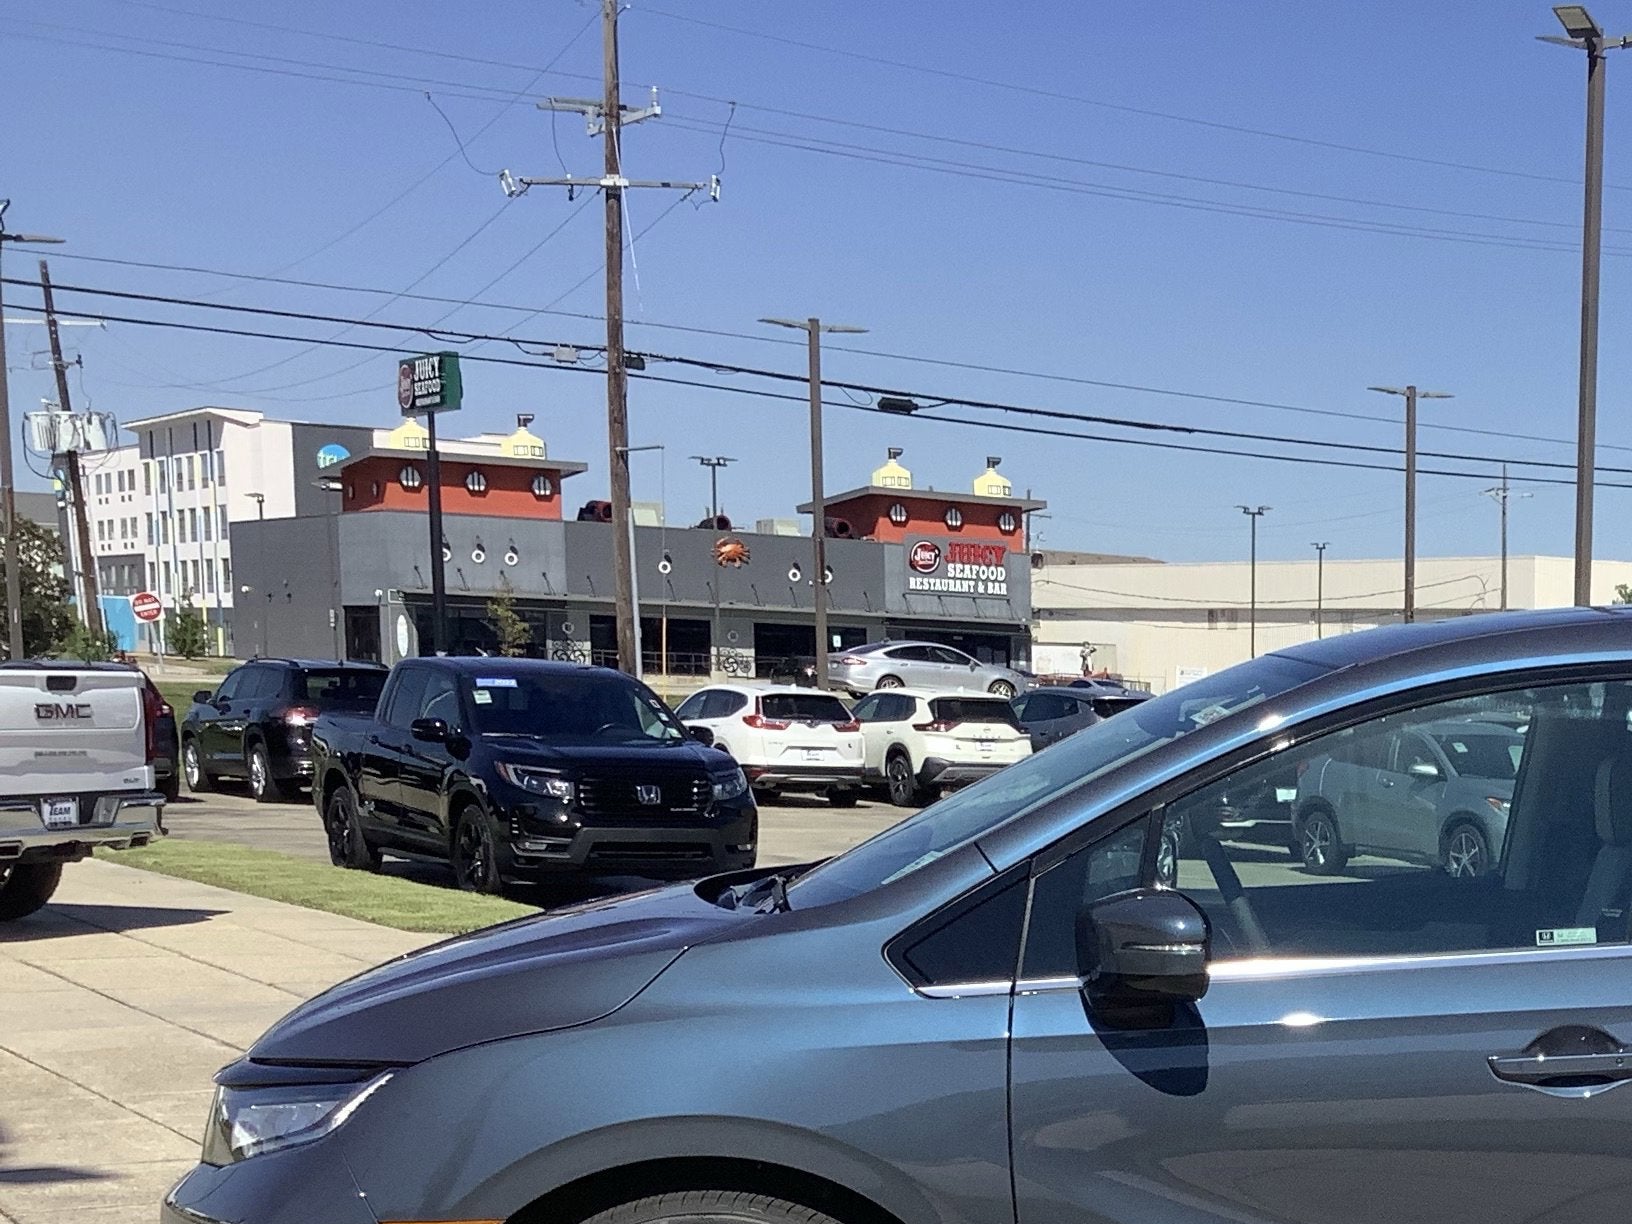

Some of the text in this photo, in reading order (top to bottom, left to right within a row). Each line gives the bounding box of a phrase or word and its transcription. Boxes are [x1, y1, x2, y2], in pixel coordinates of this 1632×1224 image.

[413, 356, 440, 381] JUICY
[944, 541, 1007, 567] JUICY
[947, 563, 1006, 581] SEAFOOD
[909, 577, 1007, 595] RESTAURANT & BAR
[34, 703, 92, 719] GMC
